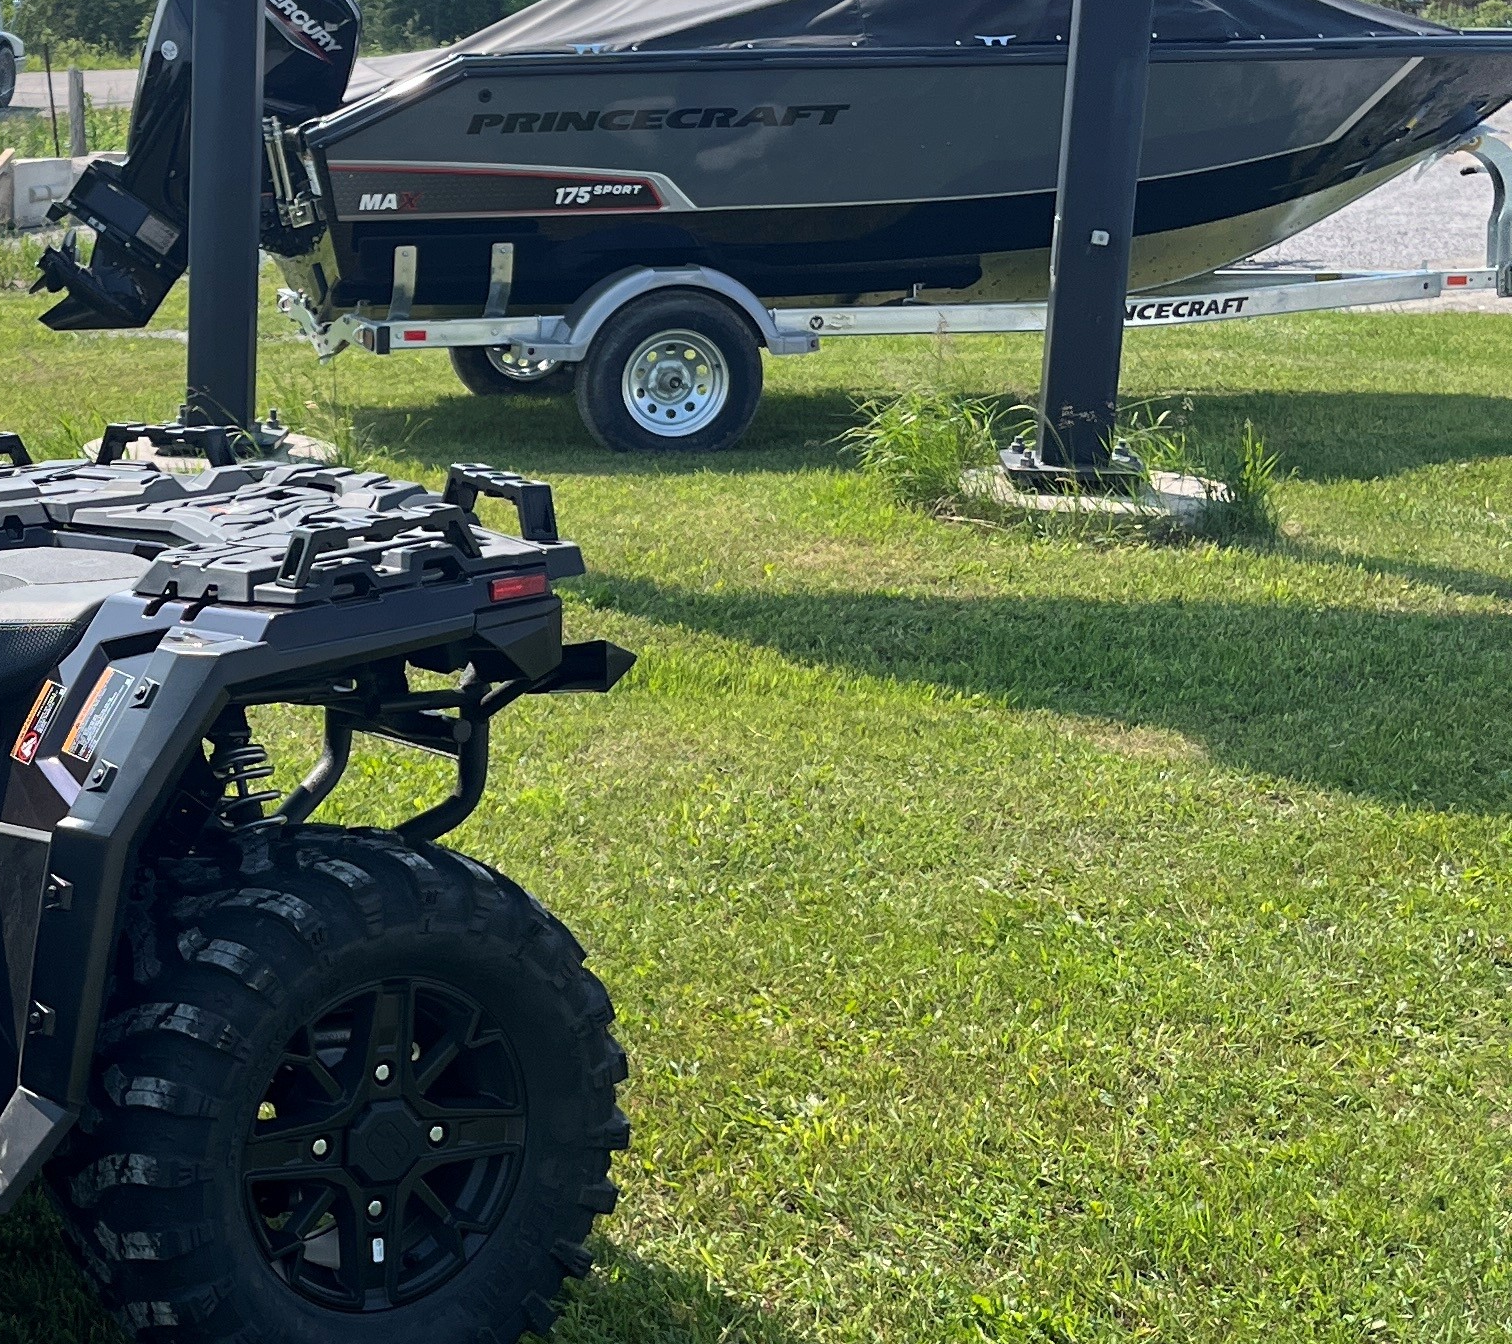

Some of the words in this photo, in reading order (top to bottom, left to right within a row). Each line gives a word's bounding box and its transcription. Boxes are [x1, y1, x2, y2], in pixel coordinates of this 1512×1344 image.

[466, 104, 851, 135] PRINCECRAFT
[358, 192, 424, 211] MAX
[555, 186, 592, 205] 175
[593, 184, 643, 196] SPORT
[1124, 297, 1249, 320] NCECRAFT
